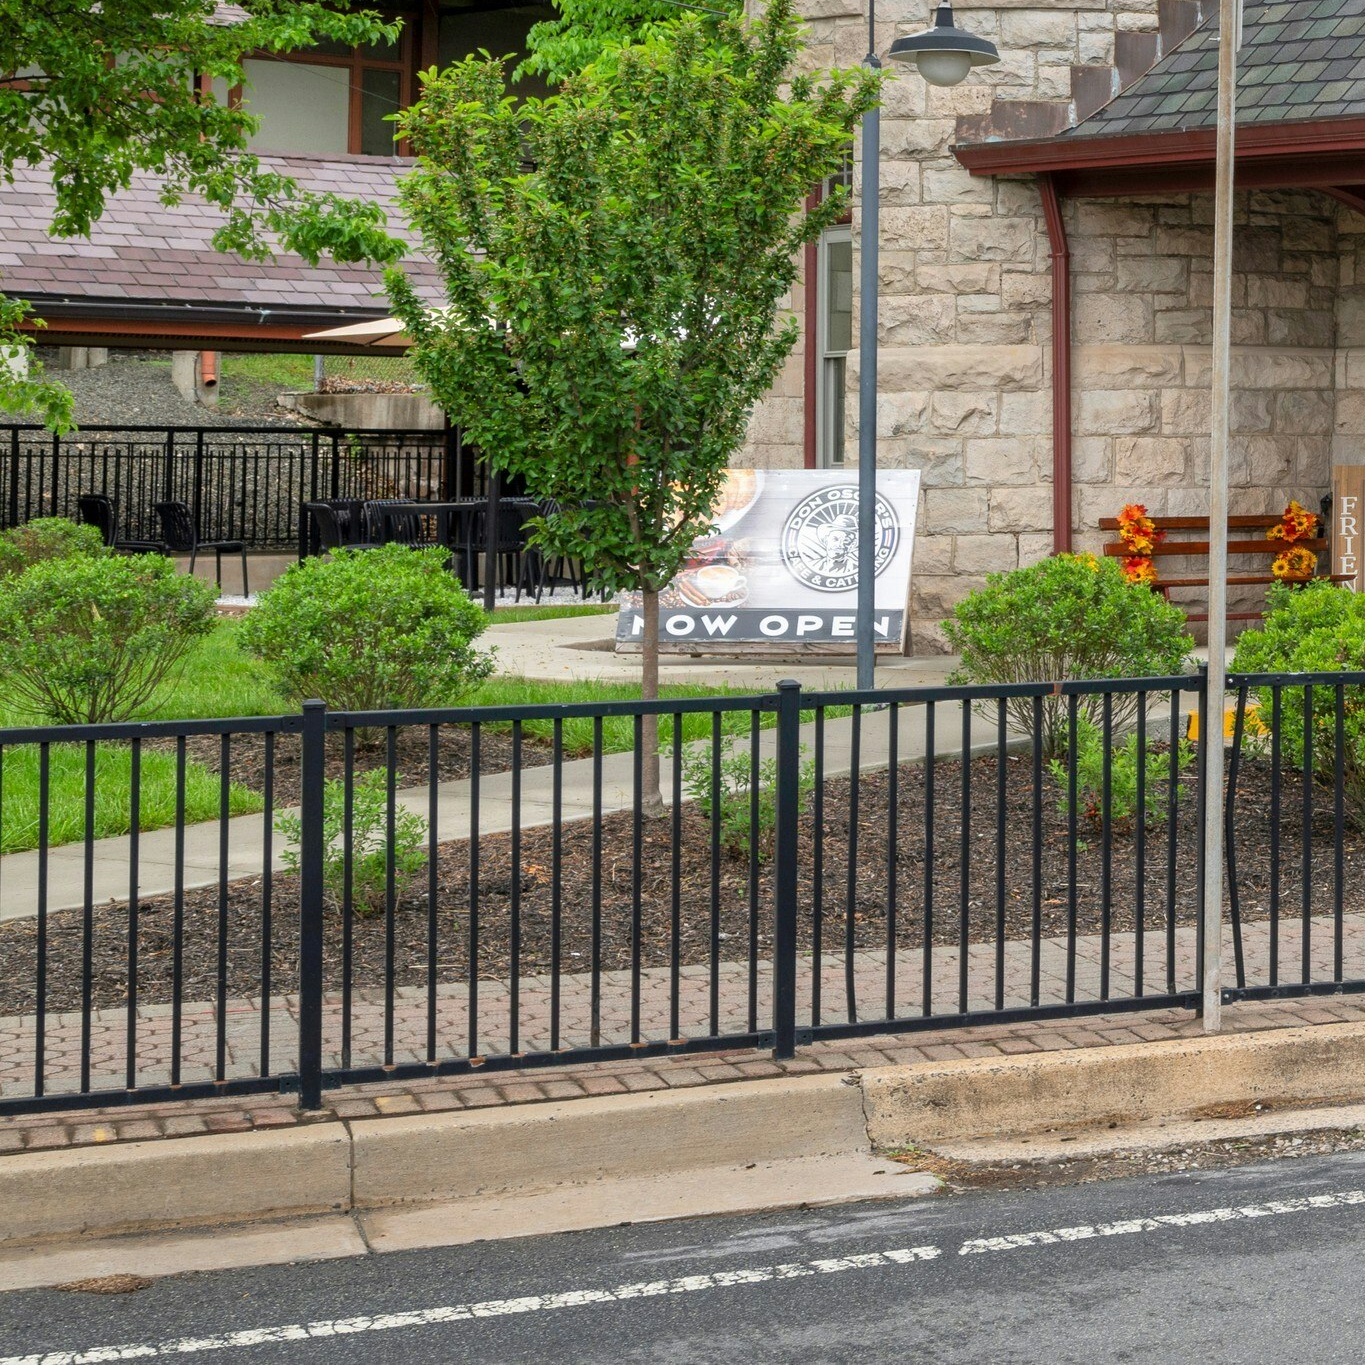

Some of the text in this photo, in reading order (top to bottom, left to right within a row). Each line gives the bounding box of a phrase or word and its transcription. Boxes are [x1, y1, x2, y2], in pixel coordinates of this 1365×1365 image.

[790, 489, 893, 530] DON OSCR'S
[811, 575, 822, 585] &
[825, 547, 890, 588] CATNG
